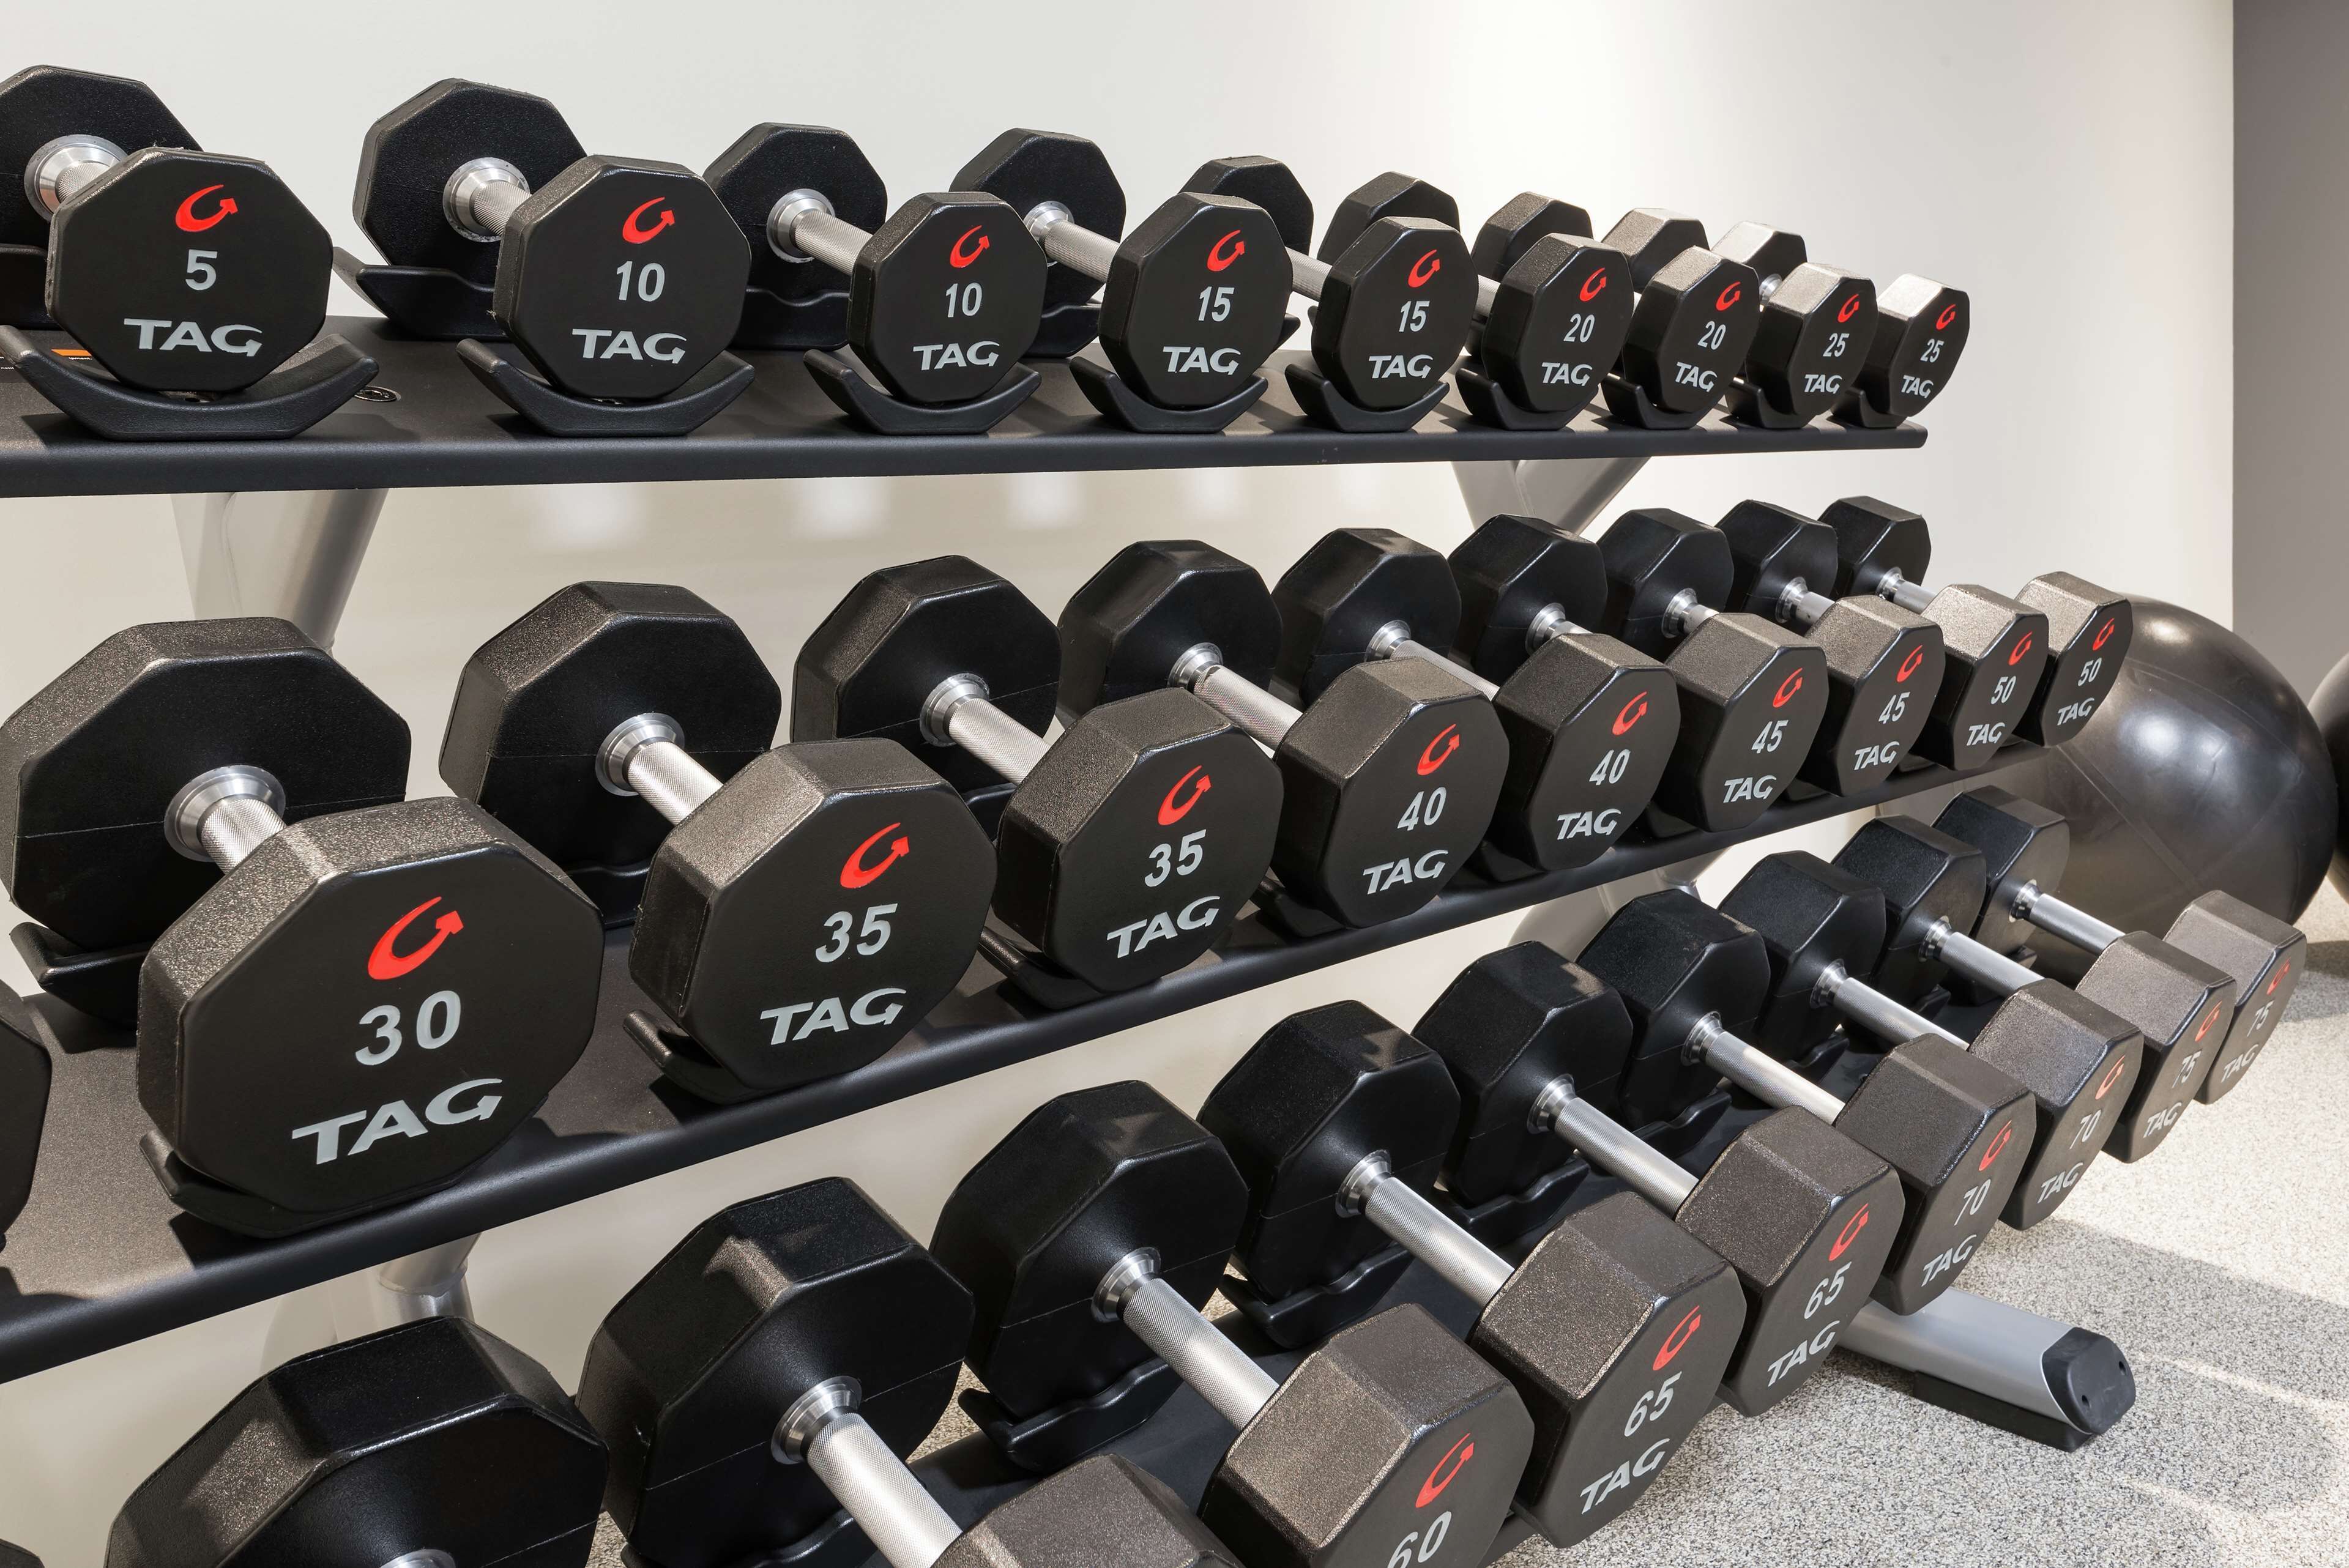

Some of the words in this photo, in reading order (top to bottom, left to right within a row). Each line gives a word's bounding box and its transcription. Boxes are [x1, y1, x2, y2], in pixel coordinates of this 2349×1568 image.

[186, 250, 217, 290] 5
[617, 261, 664, 302] 10
[946, 283, 981, 318] 10
[1199, 287, 1234, 321] 15
[1399, 301, 1426, 332] 15
[124, 319, 262, 356] TAG
[1564, 314, 1595, 342] 20
[1698, 321, 1725, 349] 20
[1823, 333, 1849, 357] 25
[572, 329, 687, 363] TAG
[913, 341, 999, 370] TAG
[1163, 346, 1240, 375] TAG
[1921, 339, 1944, 362] 25
[1369, 355, 1433, 378] TAG
[1542, 362, 1592, 386] TAG
[1675, 362, 1717, 392] TAG
[1804, 374, 1842, 393] TAG
[1902, 375, 1934, 398] TAG
[2078, 658, 2101, 686] 50
[1991, 676, 2016, 704] 50
[1878, 692, 1910, 724] 45
[2057, 698, 2094, 726] TAG
[1752, 720, 1788, 753] 45
[1967, 723, 2005, 746] TAG
[1589, 749, 1630, 785] 40
[1855, 741, 1899, 770] TAG
[1724, 775, 1776, 803] TAG
[1398, 787, 1446, 831] 40
[1557, 809, 1621, 840] TAG
[1145, 830, 1206, 886] 35
[1363, 850, 1448, 894] TAG
[816, 904, 898, 962] 35
[1107, 896, 1220, 959] TAG
[356, 990, 461, 1065] 30
[760, 988, 906, 1045] TAG
[2247, 1001, 2274, 1037] 75
[2172, 1050, 2202, 1088] 75
[2221, 1044, 2259, 1082] TAG
[292, 1079, 502, 1164] TAG
[2069, 1109, 2101, 1150] 70
[2143, 1102, 2183, 1139] TAG
[2038, 1162, 2083, 1204] TAG
[1954, 1179, 1991, 1226] 70
[1921, 1234, 1976, 1287] TAG
[1804, 1261, 1852, 1319] 65
[1768, 1321, 1839, 1387] TAG
[1625, 1372, 1681, 1436] 65
[1580, 1438, 1670, 1515] TAG
